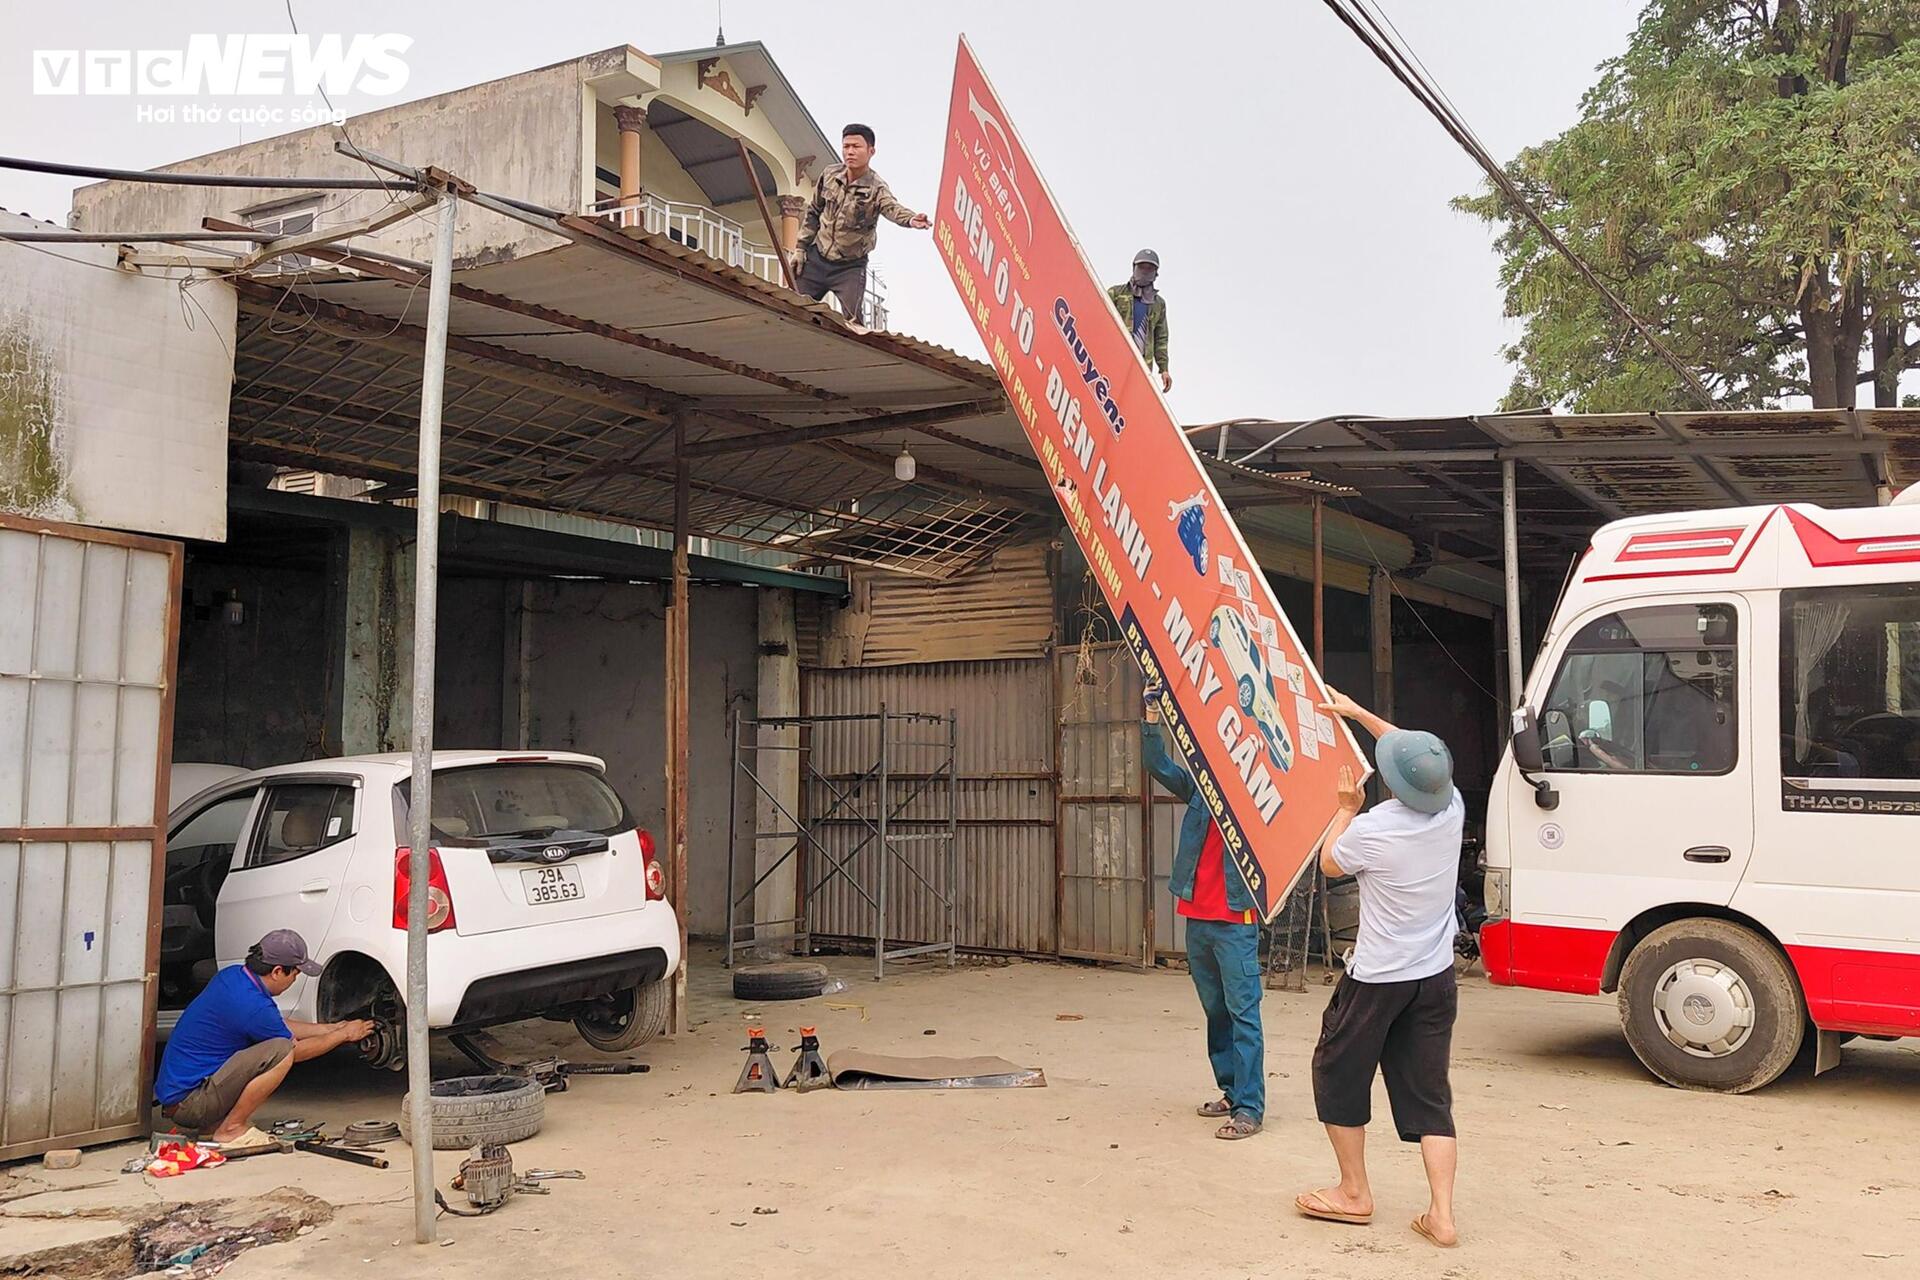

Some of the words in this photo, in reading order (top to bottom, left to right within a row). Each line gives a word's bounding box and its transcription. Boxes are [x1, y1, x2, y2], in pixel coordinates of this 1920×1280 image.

[989, 173, 1015, 221] BIÊN
[1055, 297, 1124, 435] Chuyên:
[954, 176, 993, 276] ĐIỆN
[995, 258, 1008, 304] Ô
[1011, 290, 1033, 353] TÔ
[1046, 365, 1094, 471] ĐIỆN
[1093, 459, 1151, 579] LẠNH
[1163, 597, 1221, 703] MÁY
[994, 336, 1014, 380] MÁY
[1014, 376, 1037, 428] PHÁT
[1042, 435, 1065, 482] MÁY
[1092, 533, 1122, 597] TRÌNH
[1128, 623, 1141, 652] ĐT:
[1162, 691, 1178, 725] 693
[1177, 724, 1195, 756] 687
[1200, 770, 1223, 816] 0358
[1223, 814, 1241, 853] 702
[1242, 853, 1260, 890] 113
[1785, 795, 1865, 810] THACO
[538, 868, 565, 885] 29A
[546, 847, 564, 858] KIA
[532, 883, 578, 902] 385.63
